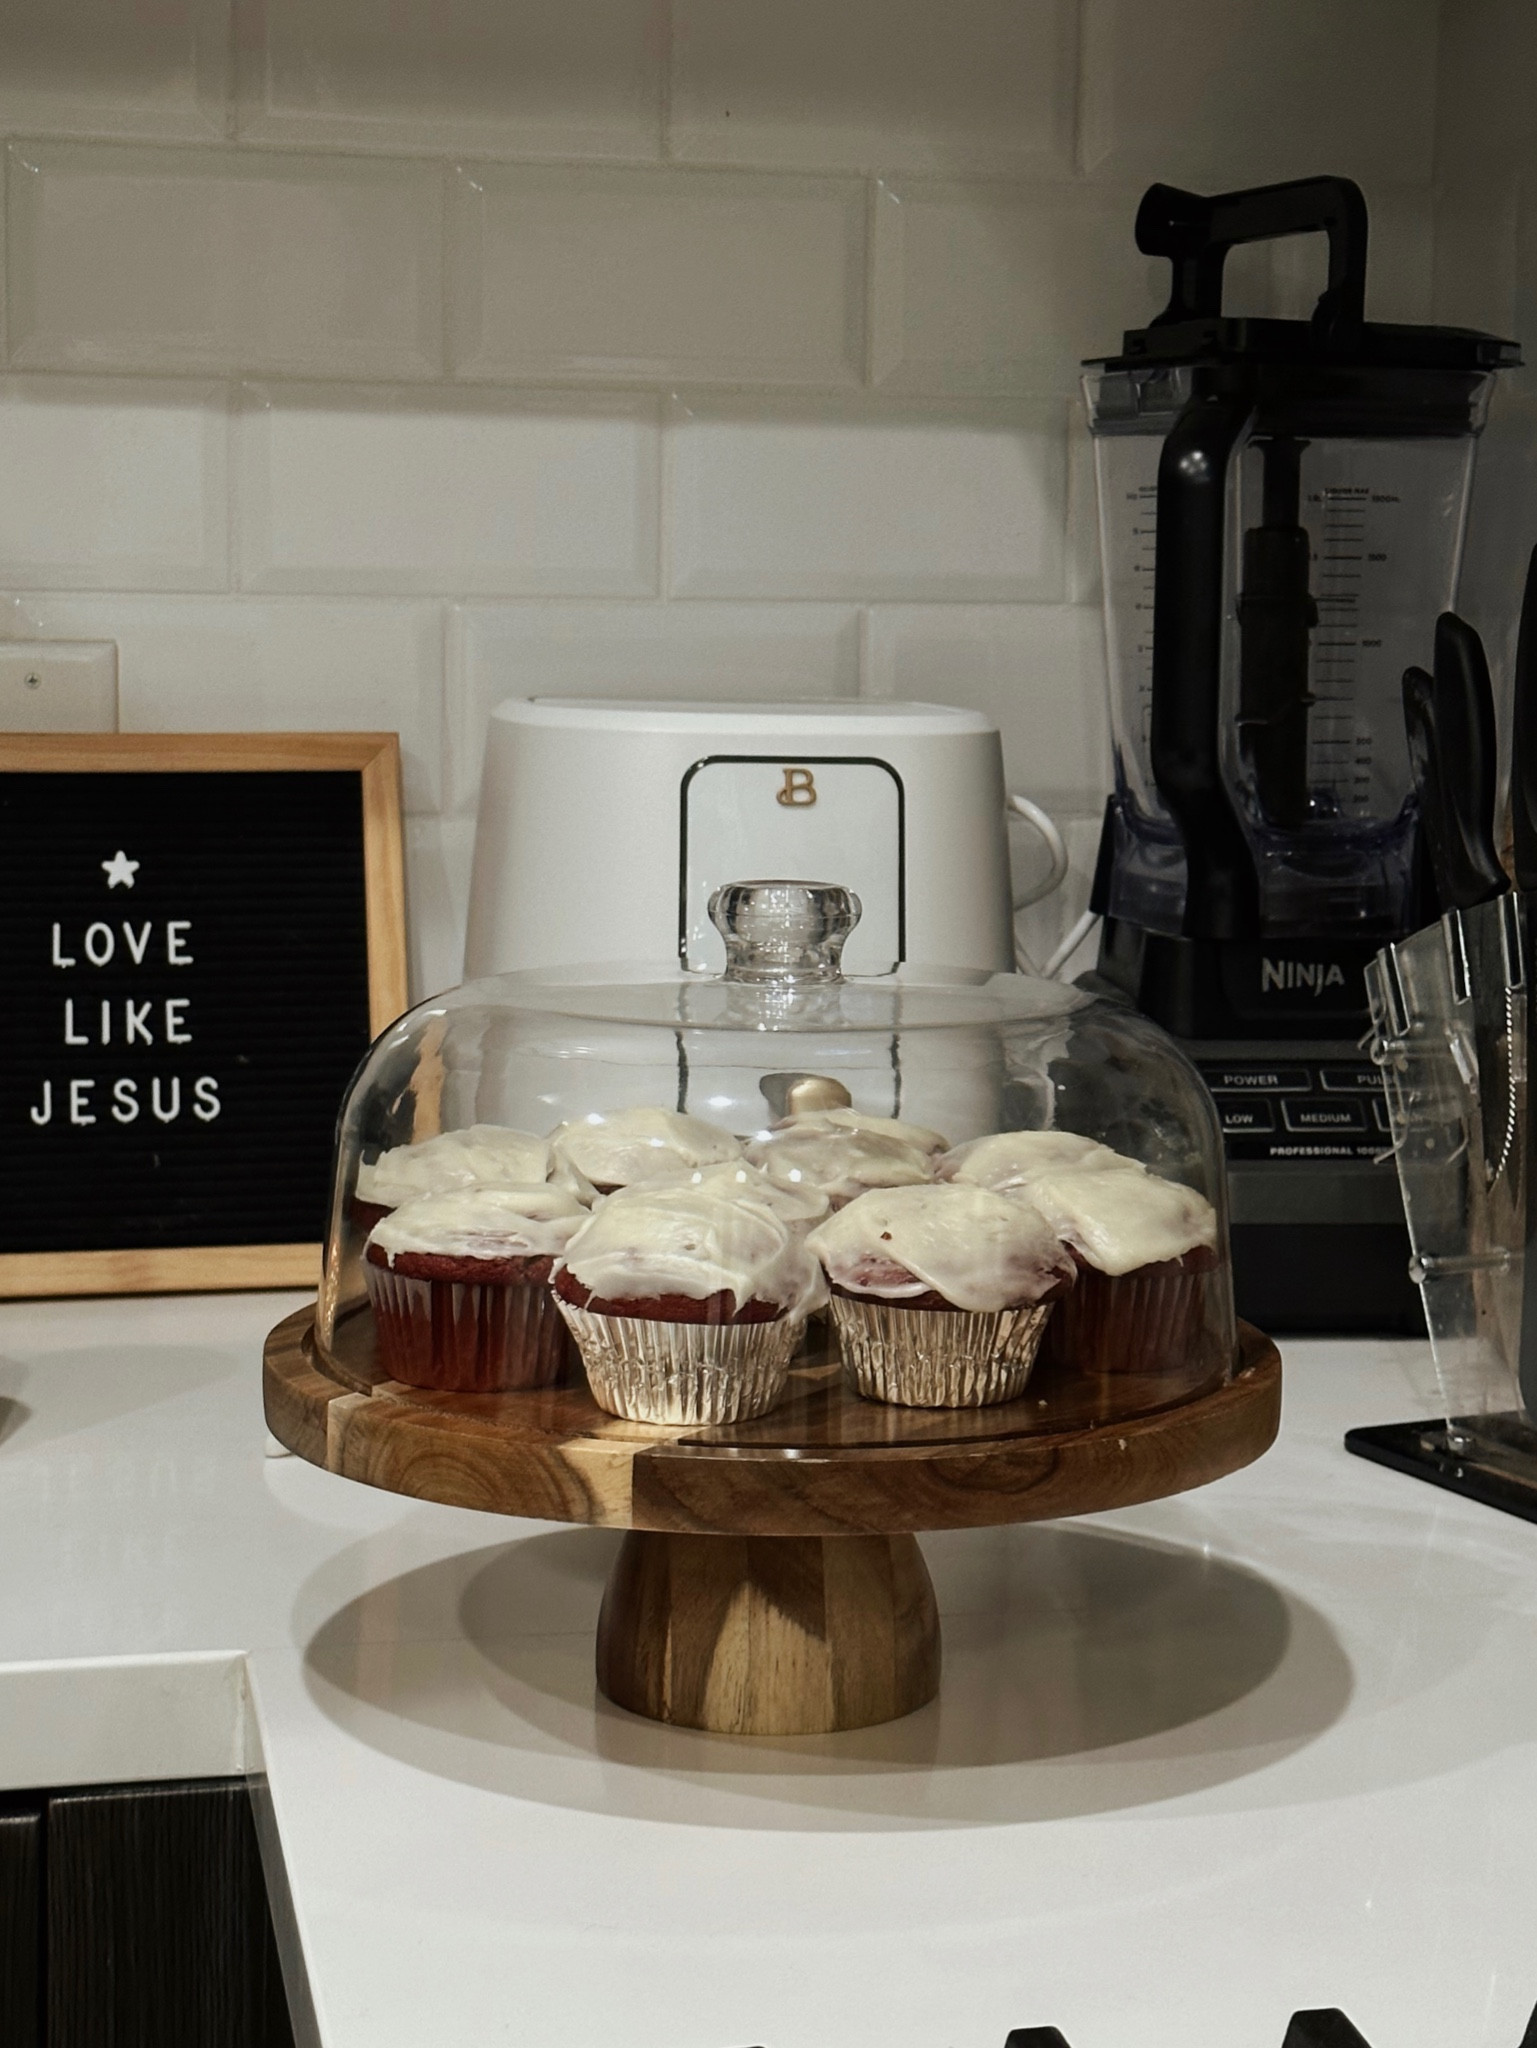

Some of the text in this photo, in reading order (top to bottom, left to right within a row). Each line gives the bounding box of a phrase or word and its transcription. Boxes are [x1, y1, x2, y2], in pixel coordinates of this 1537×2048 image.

[776, 768, 816, 806] B
[52, 920, 194, 968] LOVE
[1262, 957, 1345, 997] NINJA
[65, 998, 192, 1045] LIKE
[1224, 1075, 1279, 1086] POWER
[30, 1076, 222, 1126] JESUS
[1225, 1114, 1254, 1125] LOW
[1300, 1113, 1352, 1124] MEDIUM
[1269, 1147, 1353, 1157] PROFESSIONAL
